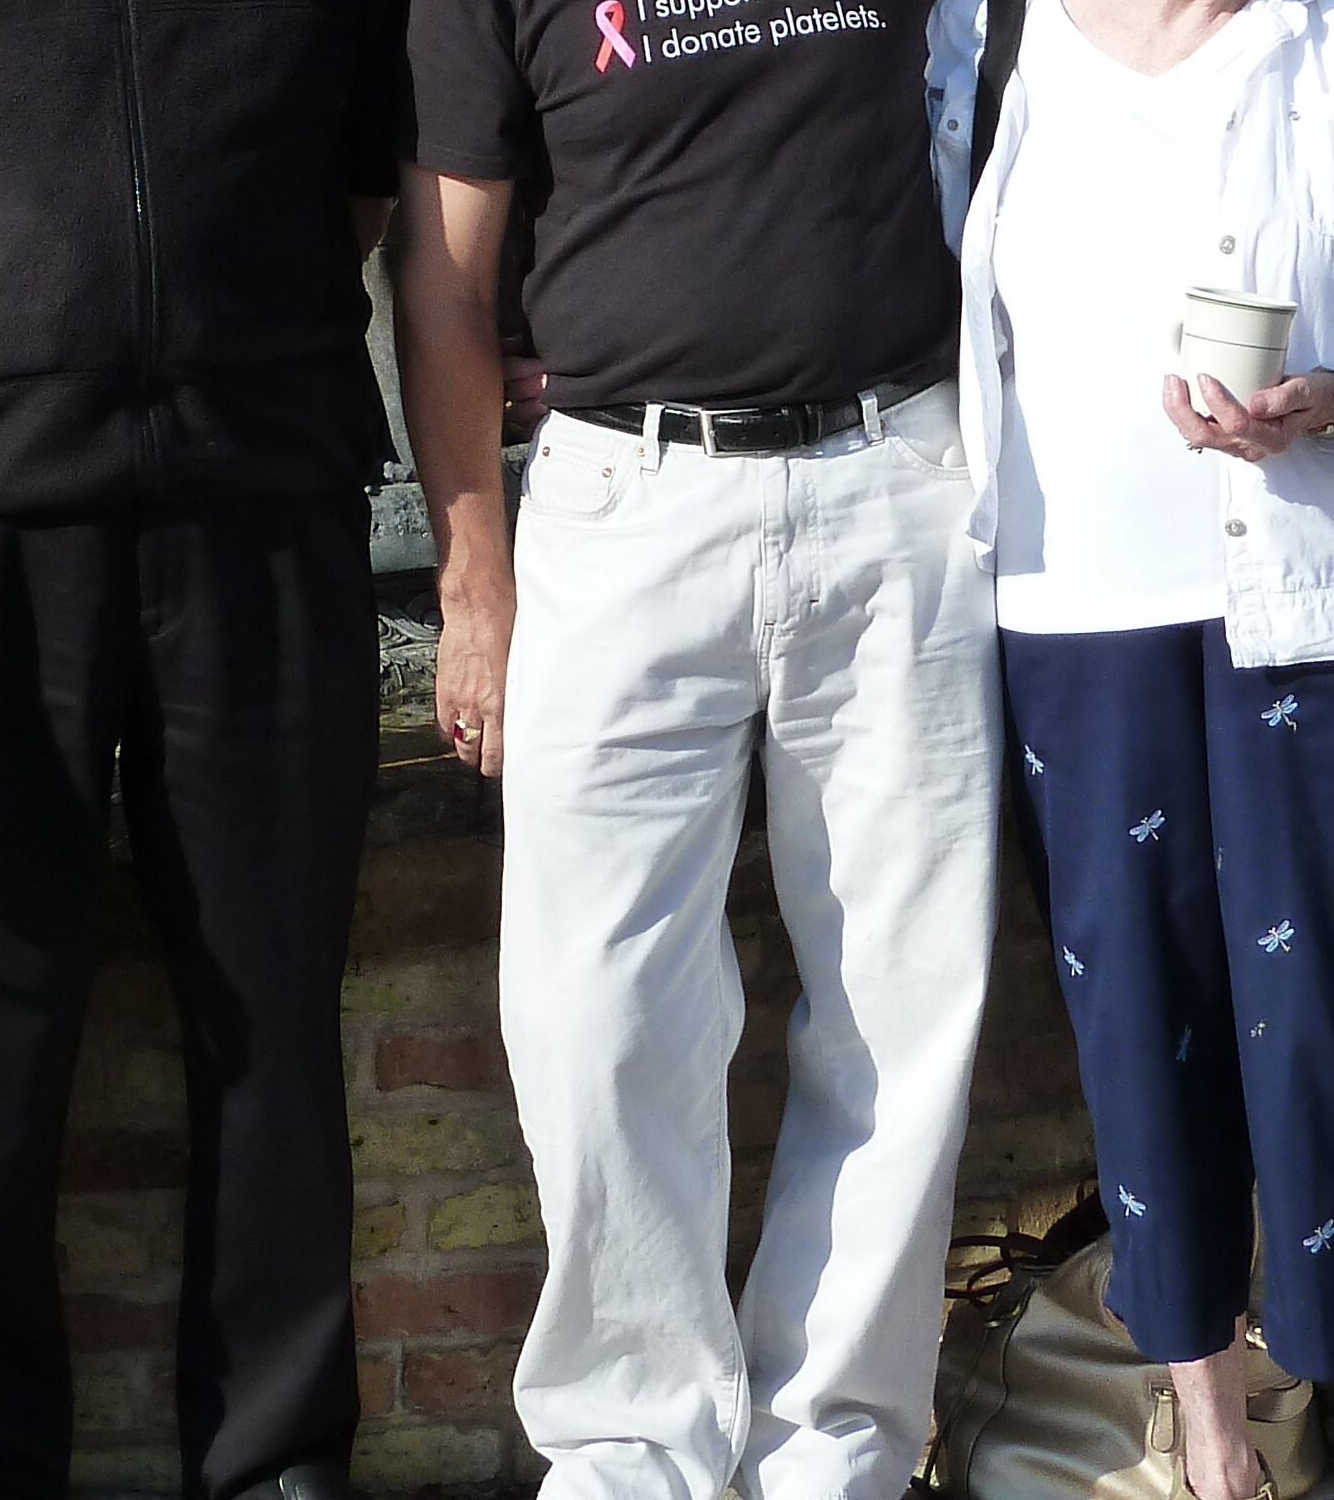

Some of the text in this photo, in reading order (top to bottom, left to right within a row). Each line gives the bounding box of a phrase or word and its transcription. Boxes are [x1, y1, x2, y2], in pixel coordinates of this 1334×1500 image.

[643, 1, 887, 63] I donate platelets.
